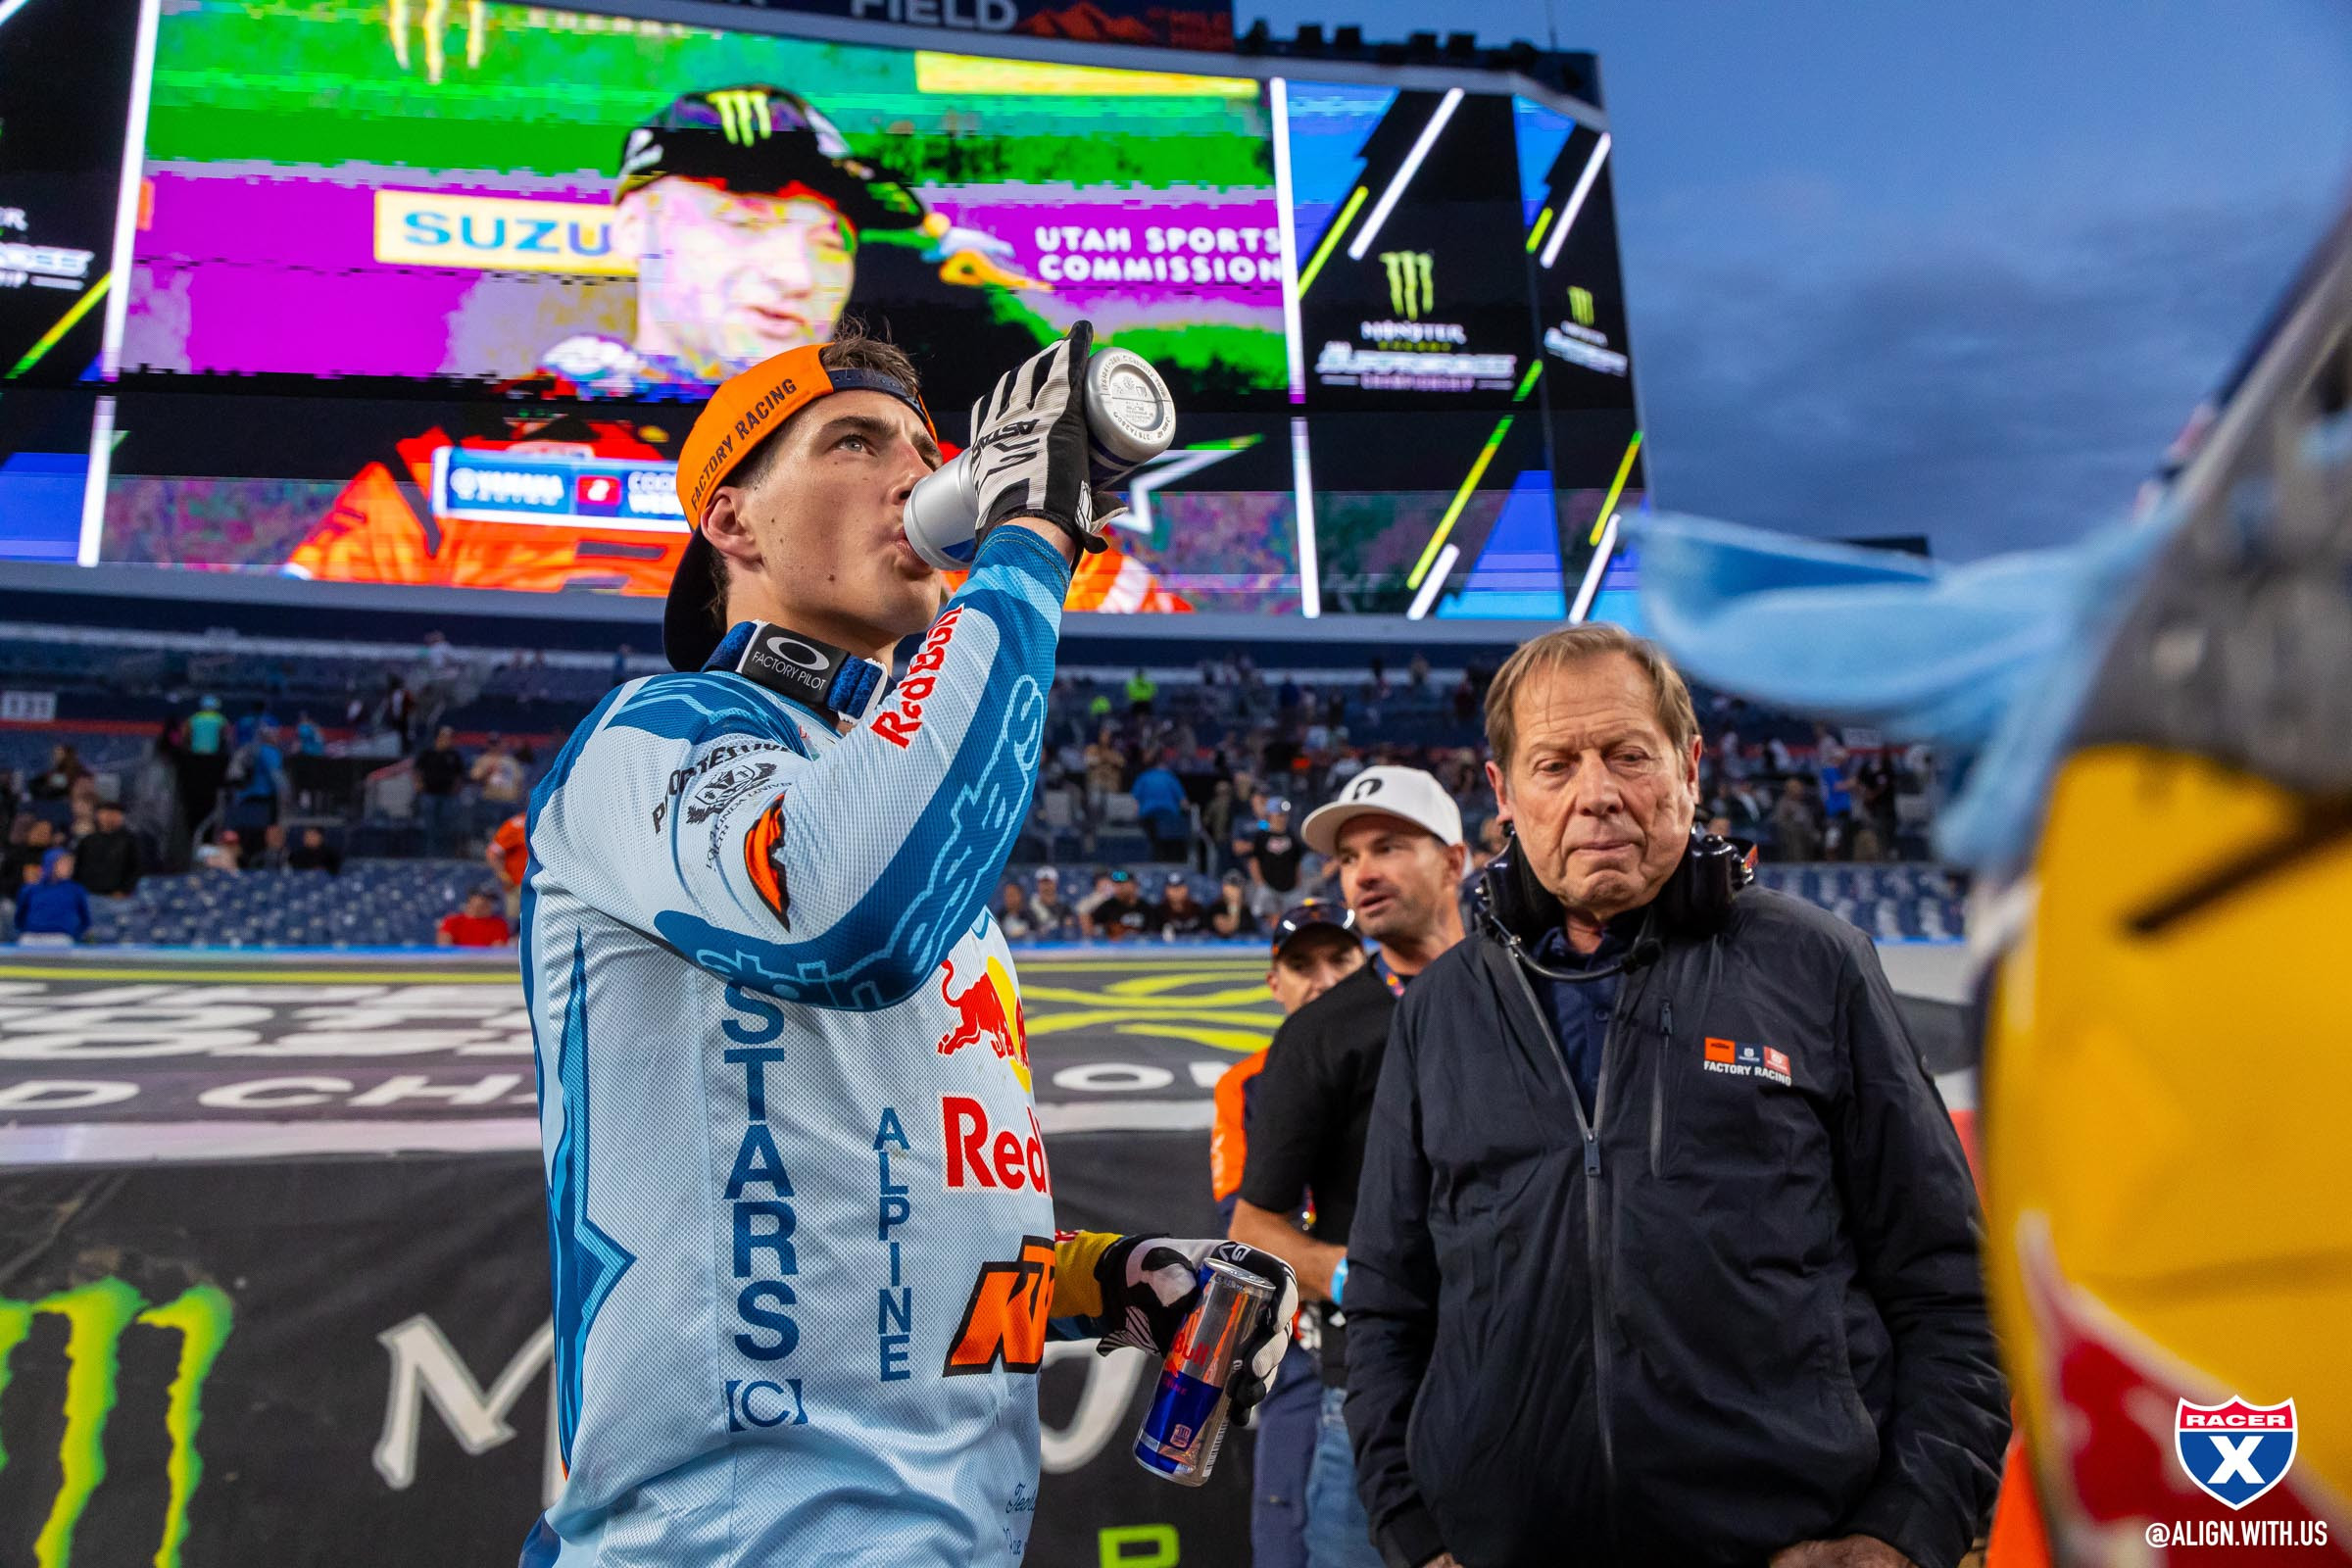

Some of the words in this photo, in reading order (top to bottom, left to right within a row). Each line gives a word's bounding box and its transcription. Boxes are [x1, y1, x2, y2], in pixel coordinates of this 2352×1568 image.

[403, 211, 612, 257] SUZU
[1035, 225, 1132, 253] UTAH
[1145, 225, 1282, 254] SPORTS
[1038, 254, 1283, 283] COMMISSION
[691, 434, 734, 512] FACTORY
[735, 378, 797, 440] RACING
[752, 651, 797, 678] FACTORY
[797, 670, 827, 691] PILOT
[1703, 1060, 1751, 1076] FACTORY
[1754, 1066, 1792, 1087] RACING
[721, 978, 800, 1360] STARS
[873, 1107, 911, 1382] ALPINE
[943, 1235, 1055, 1377] KT
